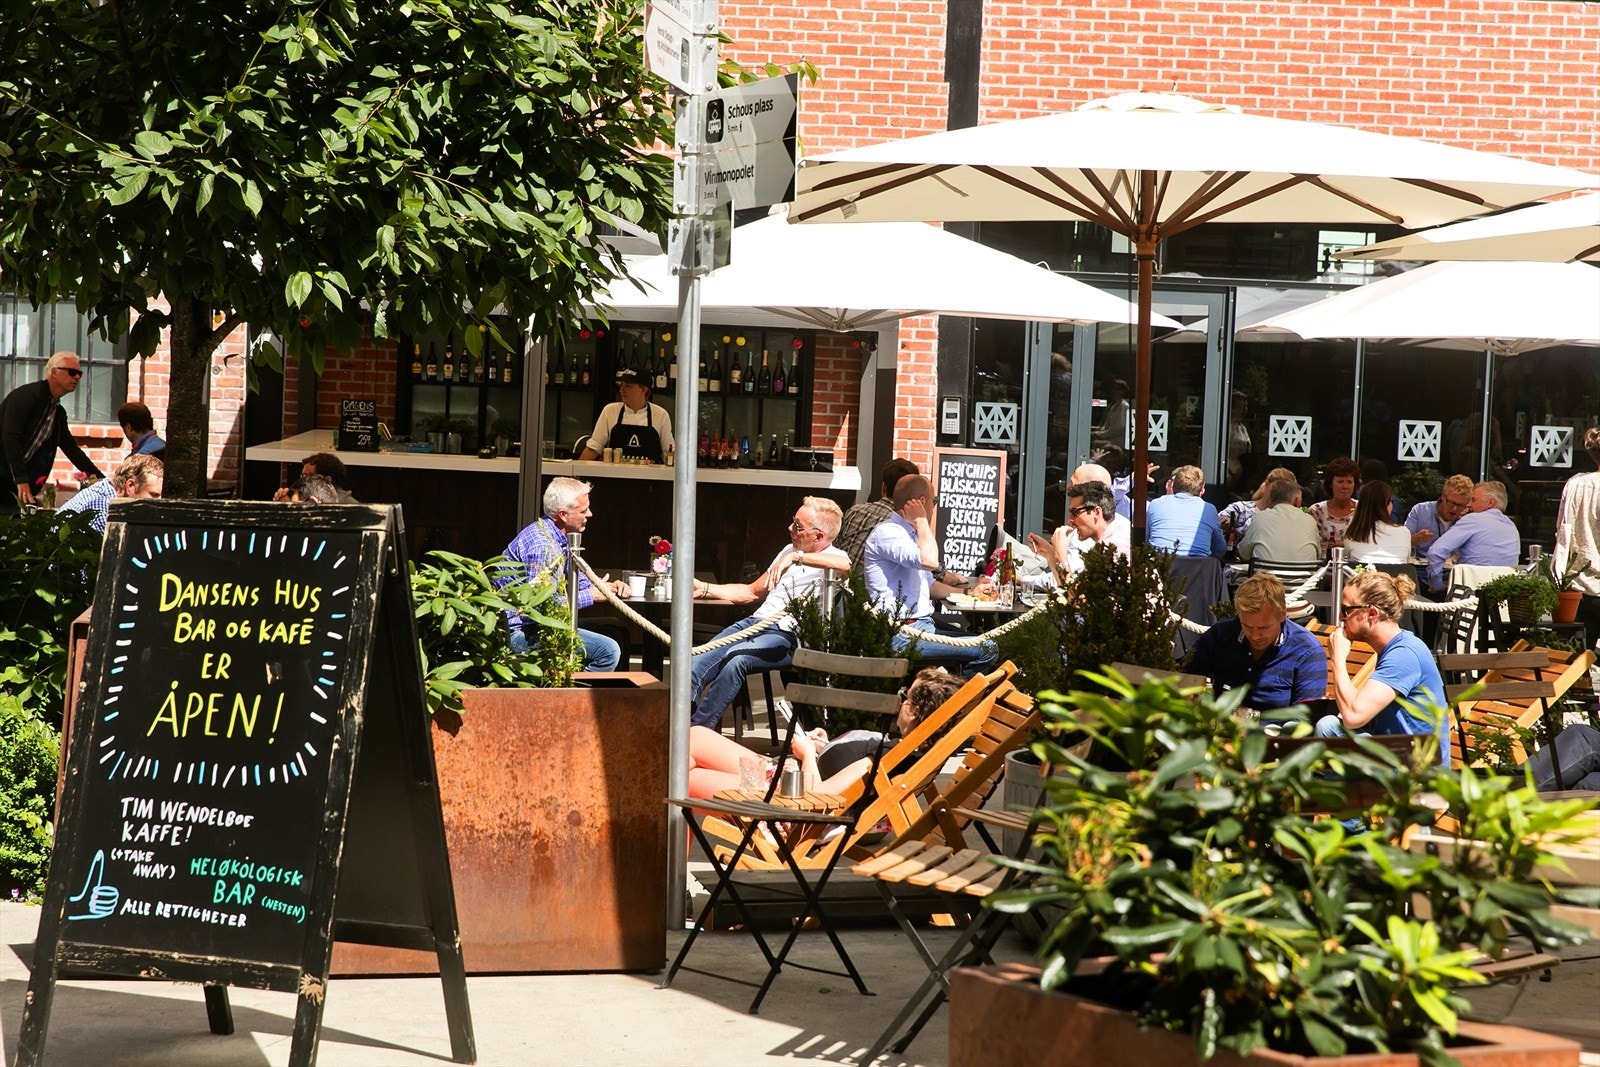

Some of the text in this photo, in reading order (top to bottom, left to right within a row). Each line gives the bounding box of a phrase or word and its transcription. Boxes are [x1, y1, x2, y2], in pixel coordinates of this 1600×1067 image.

[728, 99, 774, 119] Schous plass
[704, 164, 755, 185] Vinmonopolet
[950, 508, 985, 526] REKER
[944, 538, 987, 556] ØSTERS
[159, 573, 322, 612] DANSENS HUS
[174, 612, 216, 643] BAR
[201, 652, 232, 680] ER
[121, 797, 255, 828] TIM WENDELBOE
[122, 821, 193, 846] KAFFE!
[133, 862, 176, 879] AWAY)
[120, 898, 247, 927] ALLE RETTIGHETER
[213, 880, 306, 924] BAR (NESTEN)
